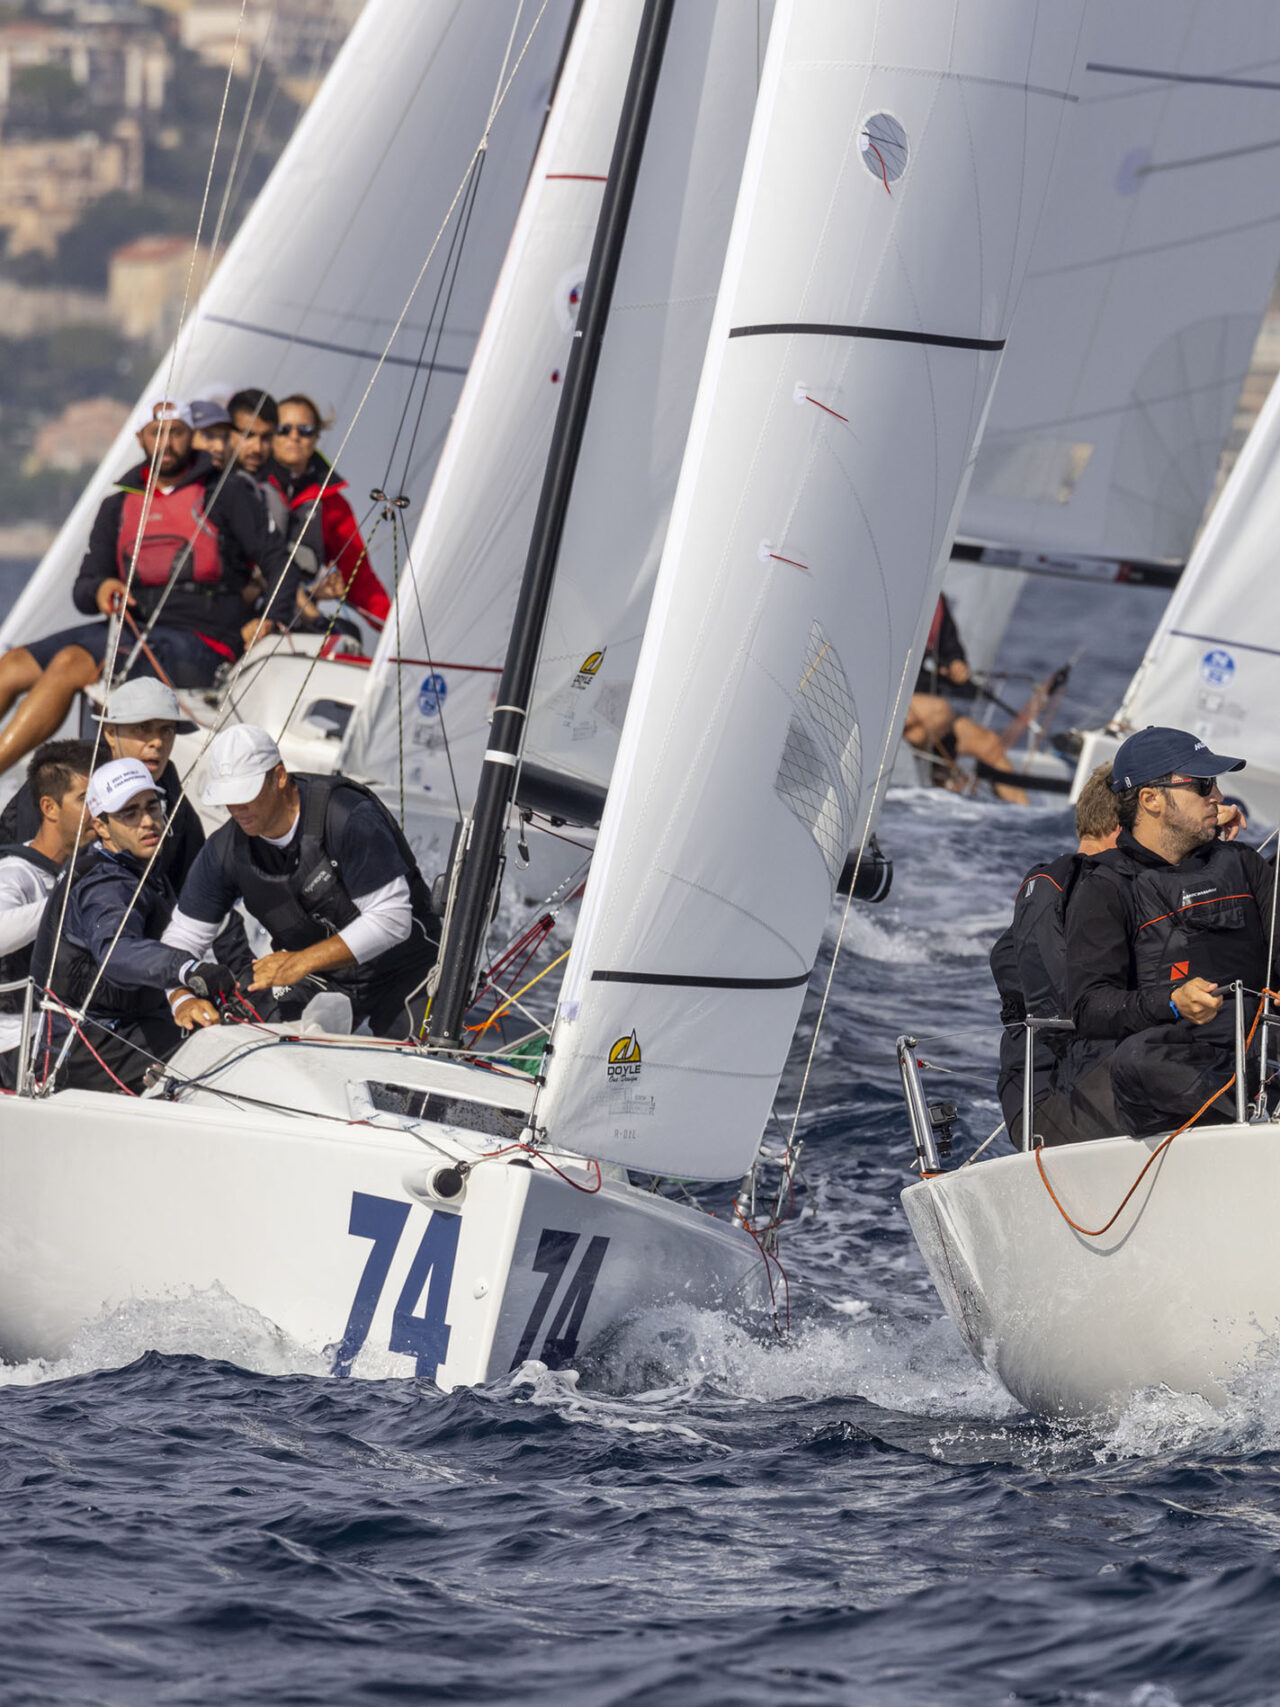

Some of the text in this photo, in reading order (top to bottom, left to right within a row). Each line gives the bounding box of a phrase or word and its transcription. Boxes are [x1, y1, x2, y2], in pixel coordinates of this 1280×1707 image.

[607, 1064, 641, 1076] DOYLE
[330, 1190, 463, 1380] 74
[508, 1228, 611, 1374] 74
